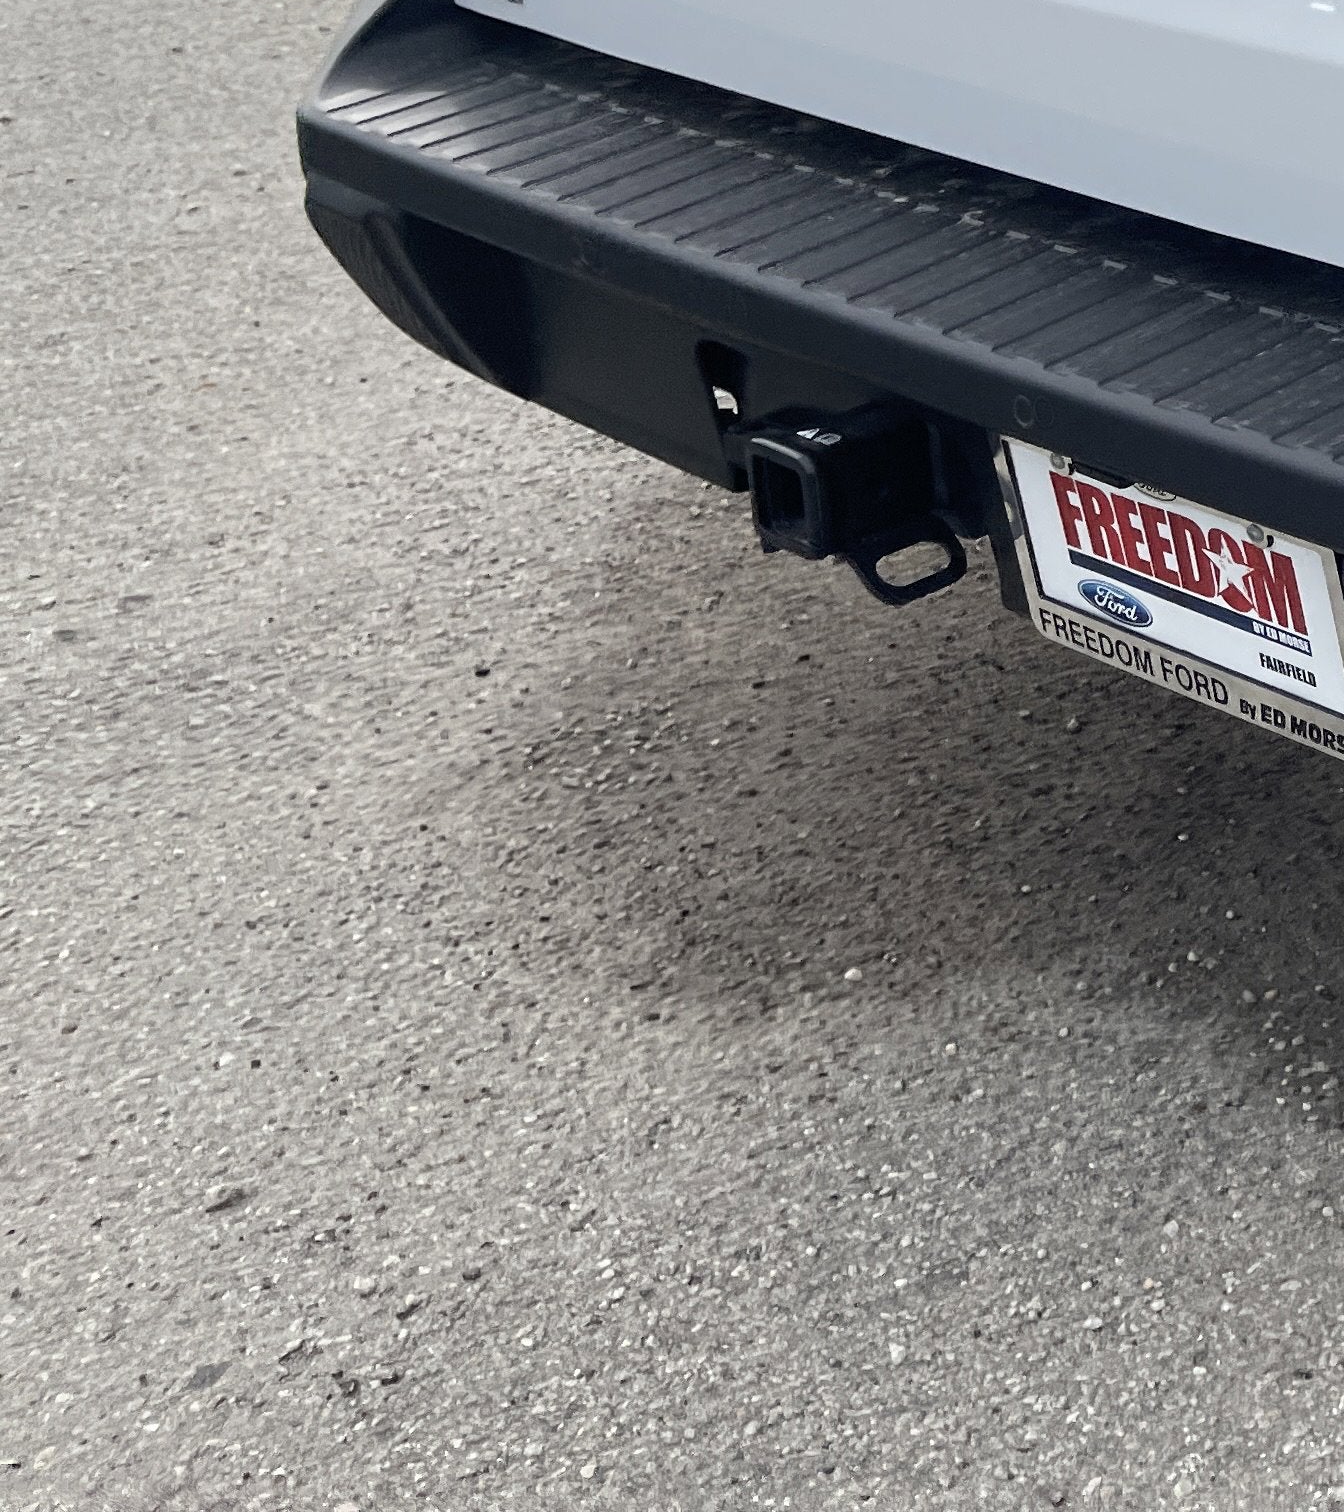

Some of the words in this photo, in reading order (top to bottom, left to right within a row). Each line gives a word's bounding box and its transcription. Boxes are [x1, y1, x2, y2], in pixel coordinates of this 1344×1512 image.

[1048, 470, 1309, 637] FREEDOM
[1093, 585, 1139, 623] Ford
[1278, 630, 1312, 653] MORSE
[1038, 607, 1155, 677] FREEDOM
[1159, 656, 1230, 706] FORD
[1260, 702, 1286, 729] ED
[1259, 652, 1317, 688] FAIRFIELD
